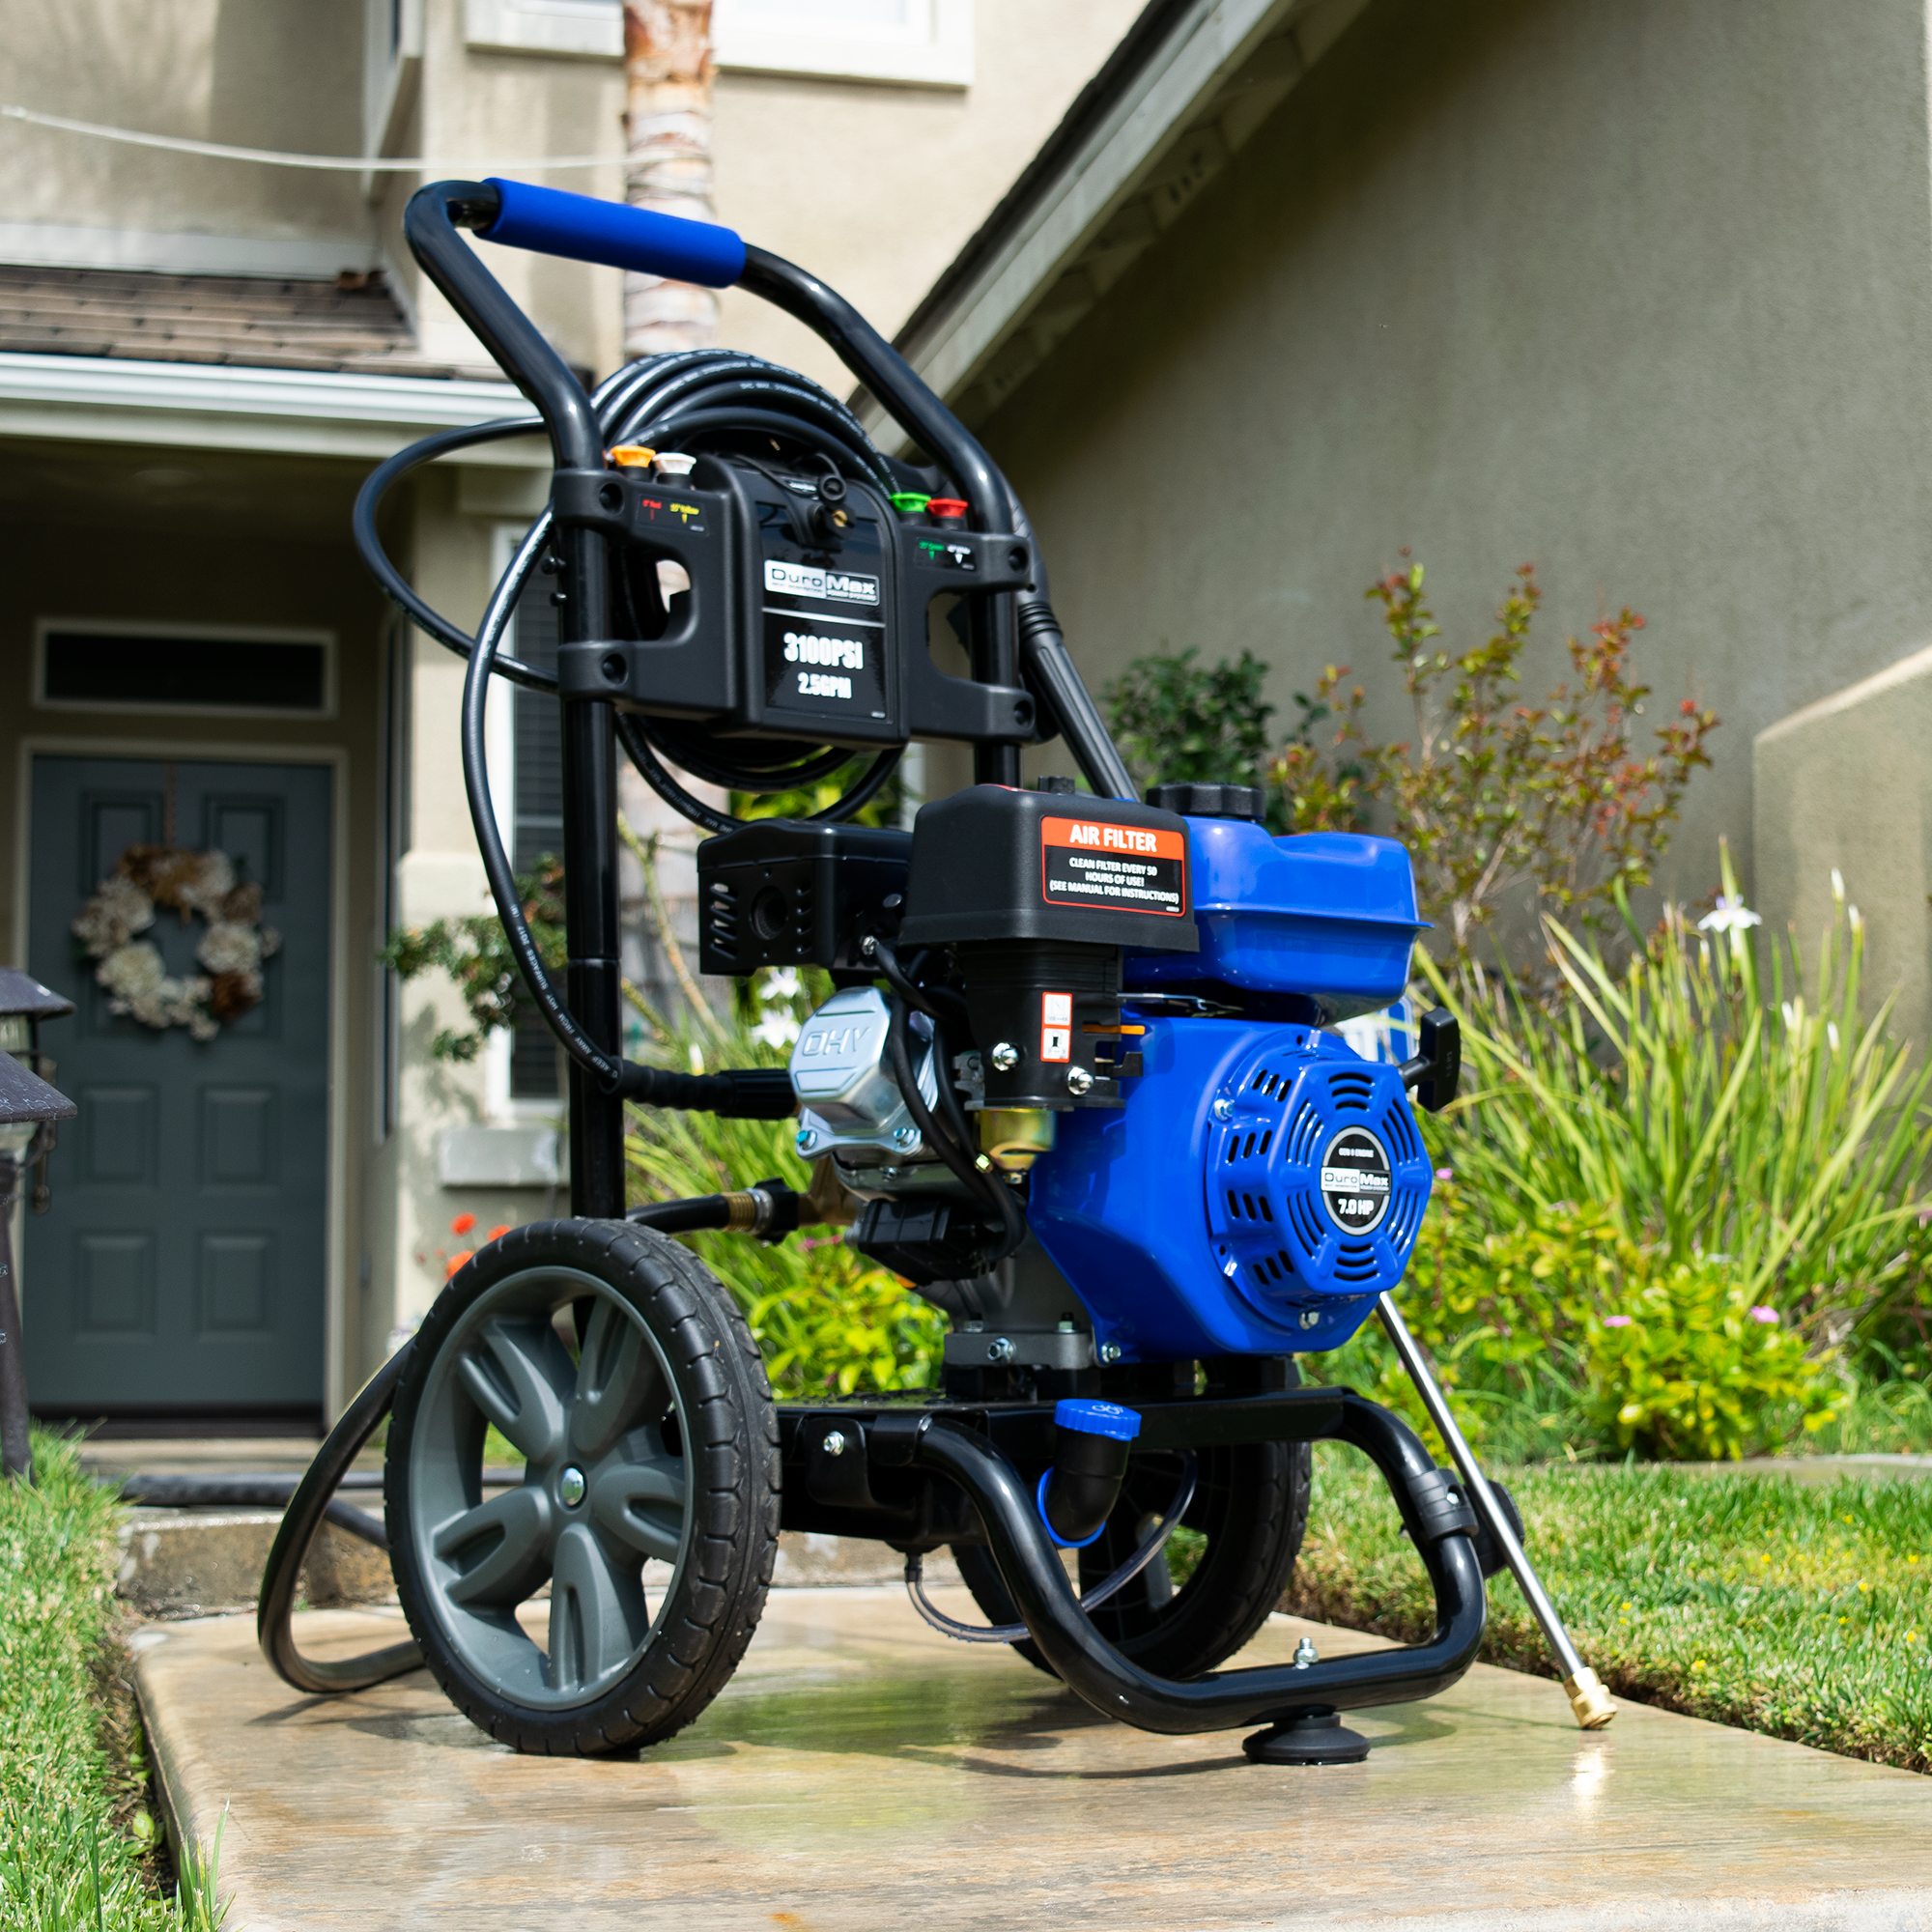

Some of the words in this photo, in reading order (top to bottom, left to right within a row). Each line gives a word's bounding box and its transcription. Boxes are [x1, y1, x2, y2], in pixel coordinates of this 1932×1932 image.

[783, 632, 864, 669] 3100PSI
[797, 672, 852, 699] 2.5GPM
[1069, 824, 1100, 846] AIR
[1103, 828, 1157, 853] FILTER
[1068, 857, 1095, 869] CLEAN
[1096, 860, 1121, 872] FILTER
[1122, 863, 1147, 875] EVERY
[1085, 871, 1114, 883] HOURS
[1114, 874, 1125, 885] OF
[1126, 876, 1145, 887] USE!
[1049, 879, 1066, 892] (SEE
[1067, 882, 1103, 895] MANUAL
[1104, 886, 1121, 896] FOR
[1122, 888, 1179, 904] INSTRUCTIONS)
[525, 949, 549, 990] SURFACES
[545, 992, 559, 1010] HOT
[557, 1011, 576, 1035] FROM
[574, 1036, 592, 1055] AWAY
[802, 1027, 871, 1056] OHV
[1357, 1199, 1375, 1216] HP
